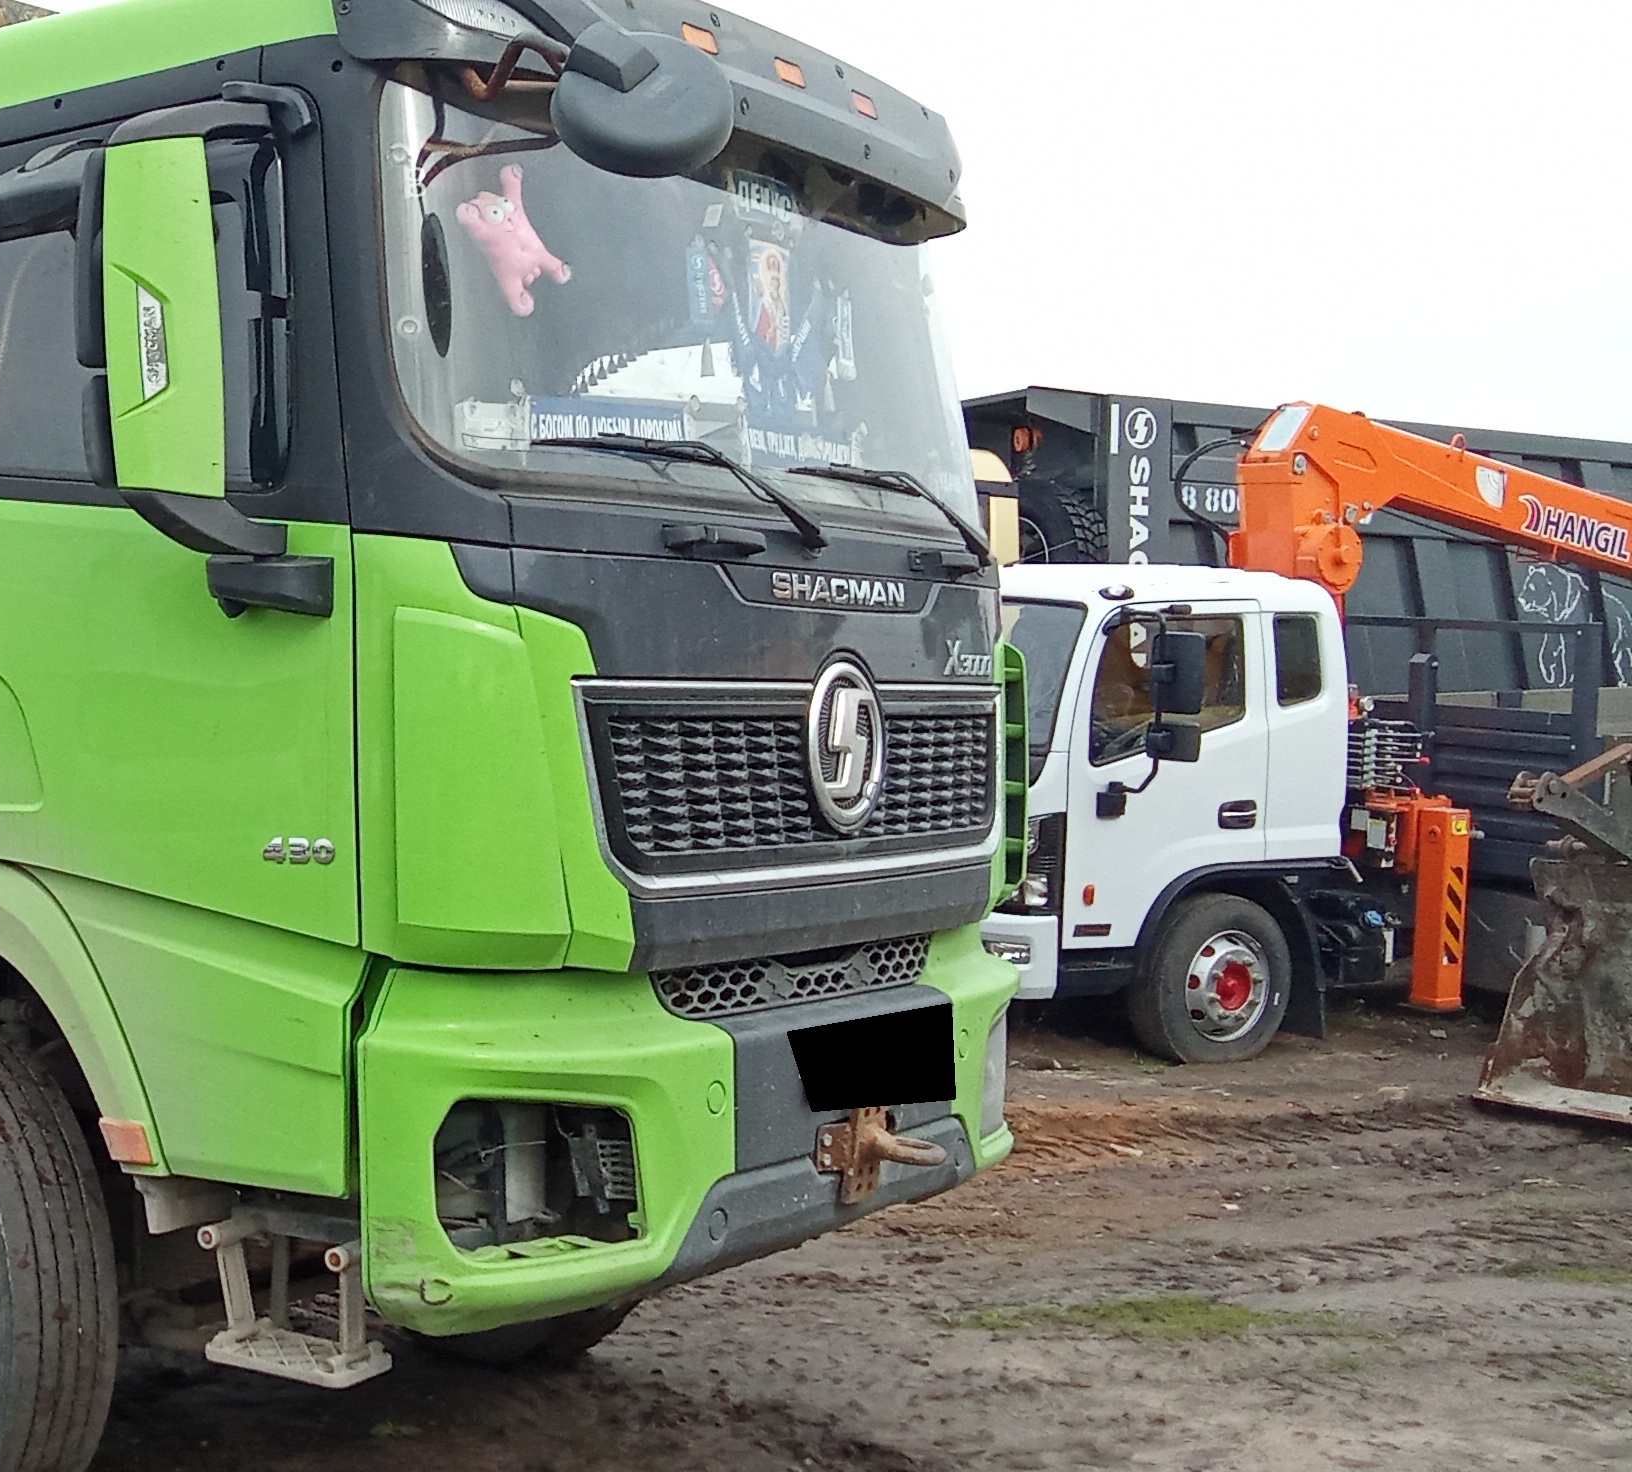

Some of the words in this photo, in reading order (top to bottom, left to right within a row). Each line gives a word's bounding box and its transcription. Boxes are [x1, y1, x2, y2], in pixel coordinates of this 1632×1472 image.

[530, 413, 537, 439] С
[539, 413, 574, 439] БОГОМ
[575, 414, 589, 439] ПО
[592, 416, 631, 438] ЛЮБЫМ
[1205, 486, 1241, 514] 80
[1541, 505, 1630, 562] HANGIL
[771, 571, 906, 608] SHACMAN
[943, 639, 992, 677] X3000
[262, 836, 335, 865] 430
